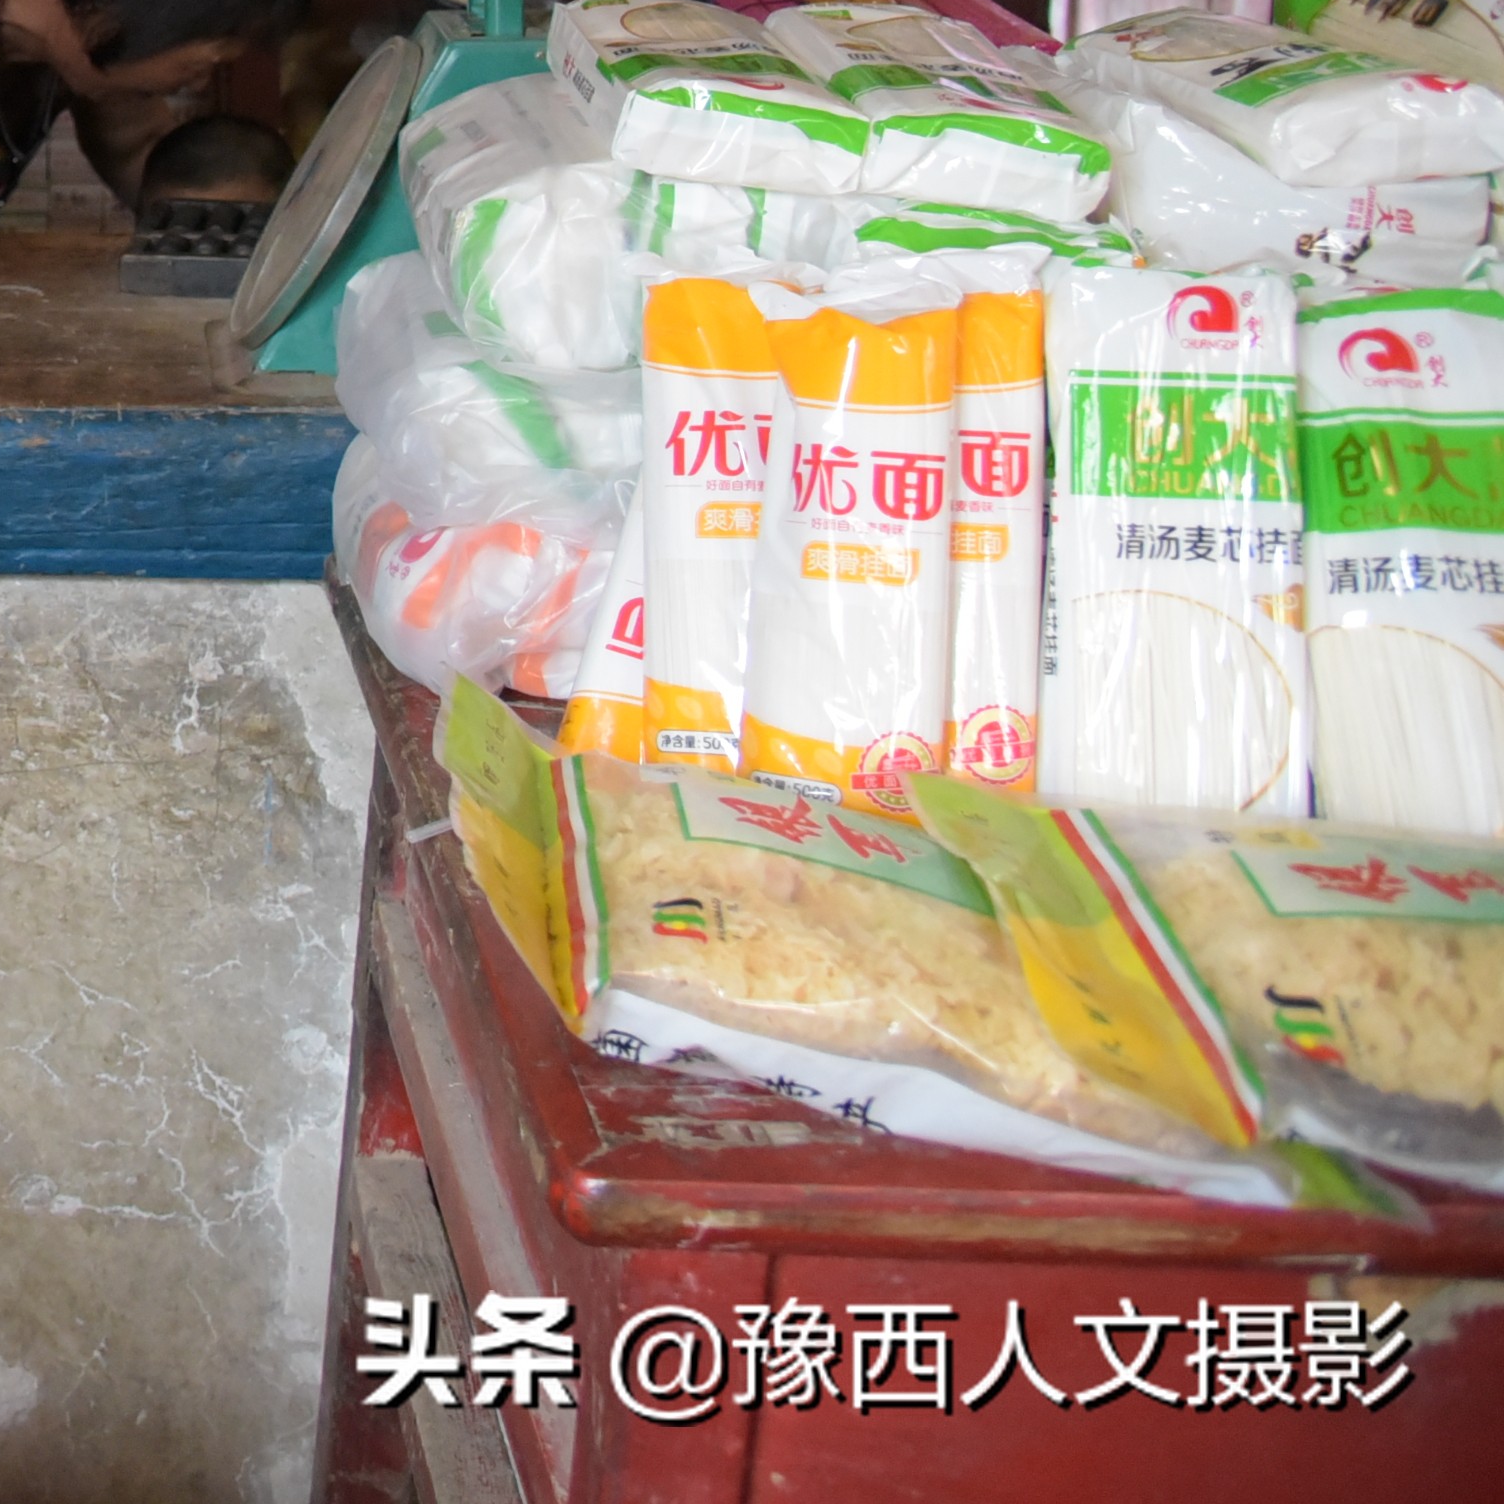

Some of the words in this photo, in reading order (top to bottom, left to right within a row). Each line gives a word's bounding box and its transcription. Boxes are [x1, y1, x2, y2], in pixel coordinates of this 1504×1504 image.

[665, 410, 773, 478] 优
[792, 445, 946, 521] 优面
[703, 507, 761, 533] 爽滑
